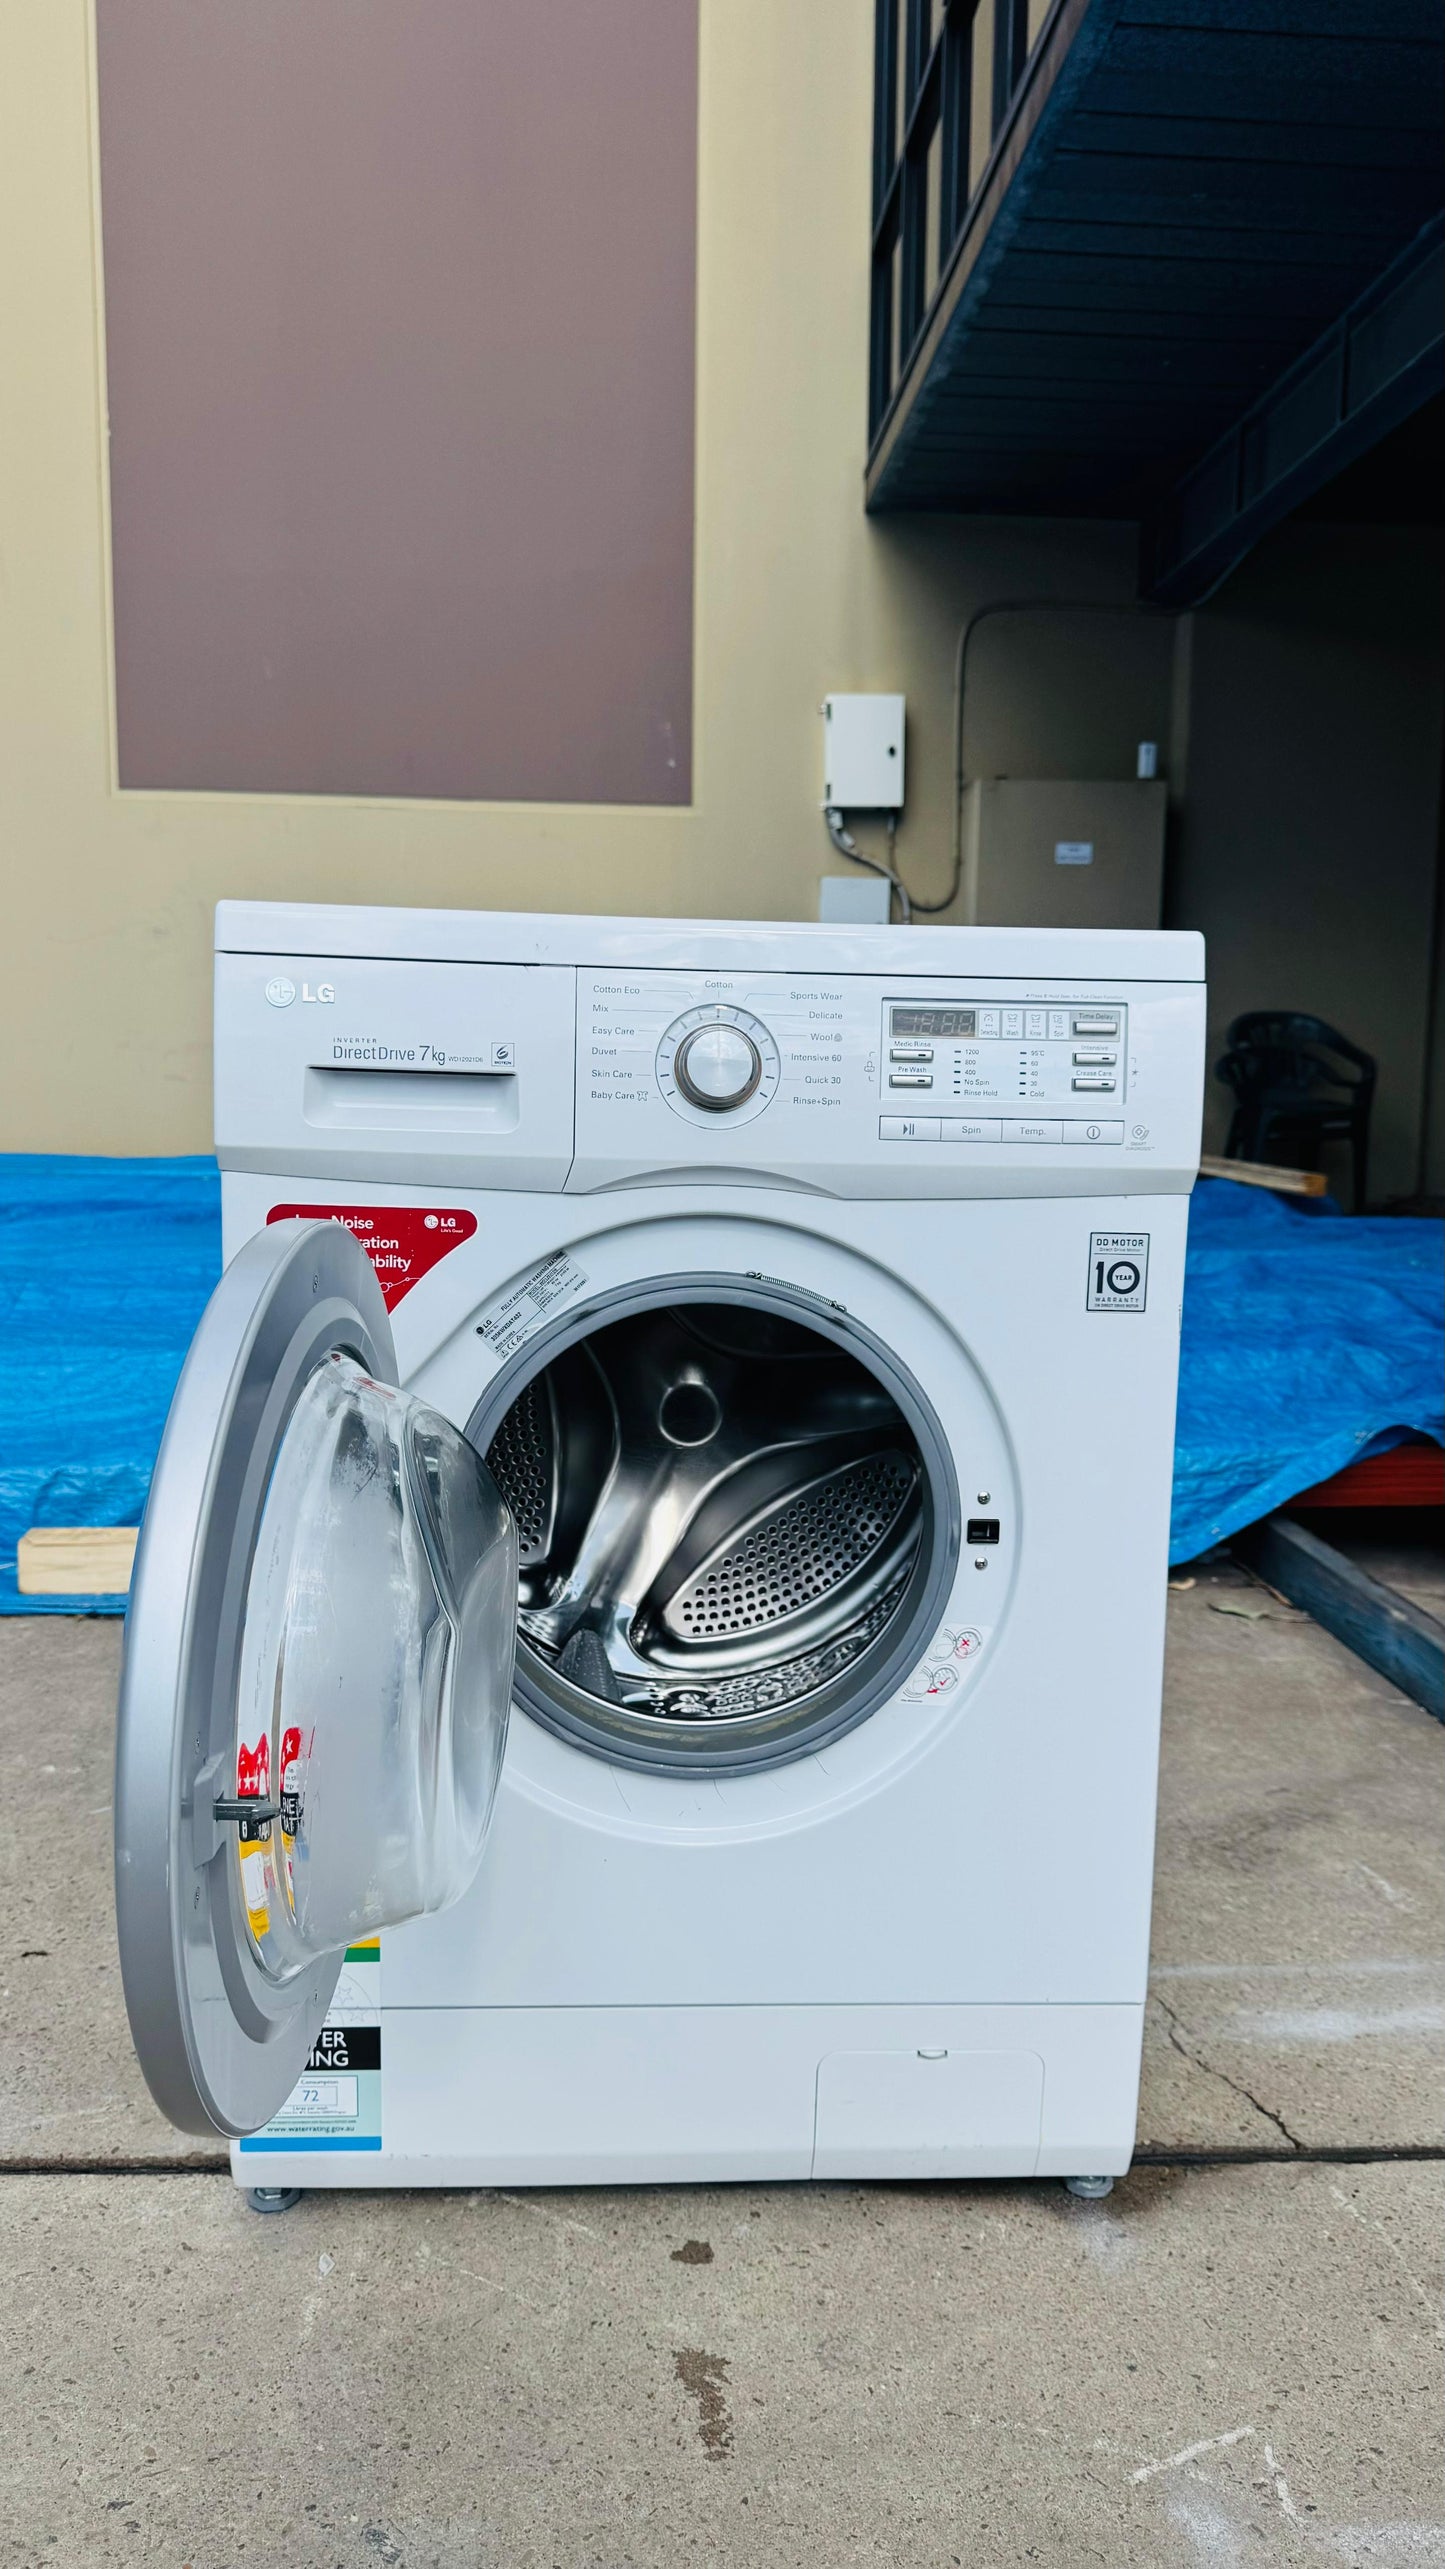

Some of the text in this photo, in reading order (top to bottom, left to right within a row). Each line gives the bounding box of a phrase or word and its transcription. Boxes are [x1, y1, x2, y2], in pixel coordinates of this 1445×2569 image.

[705, 981, 733, 989] Cotton
[302, 984, 335, 1003] LG
[594, 985, 640, 995] Cotton Eco
[791, 992, 843, 1001] Sports Wear
[592, 1027, 612, 1036] Easy
[592, 1070, 610, 1078] Skin
[805, 1076, 829, 1085] Quick
[976, 1079, 990, 1087] Spin
[592, 1091, 634, 1101] Baby Care
[793, 1098, 840, 1106] Rinse+Spin
[962, 1126, 981, 1135] Spin
[1020, 1126, 1046, 1136] Temp.
[441, 1218, 456, 1227] LG
[1096, 1238, 1144, 1247] DD MOTOR
[1096, 1261, 1140, 1294] 10
[500, 1298, 514, 1311] FULLY
[511, 1280, 534, 1301] AUTOMATIC
[531, 1265, 550, 1283] WASHING
[483, 1319, 492, 1329] LG
[322, 2031, 347, 2048] ER
[310, 2050, 349, 2067] ING
[303, 2090, 319, 2102] 72
